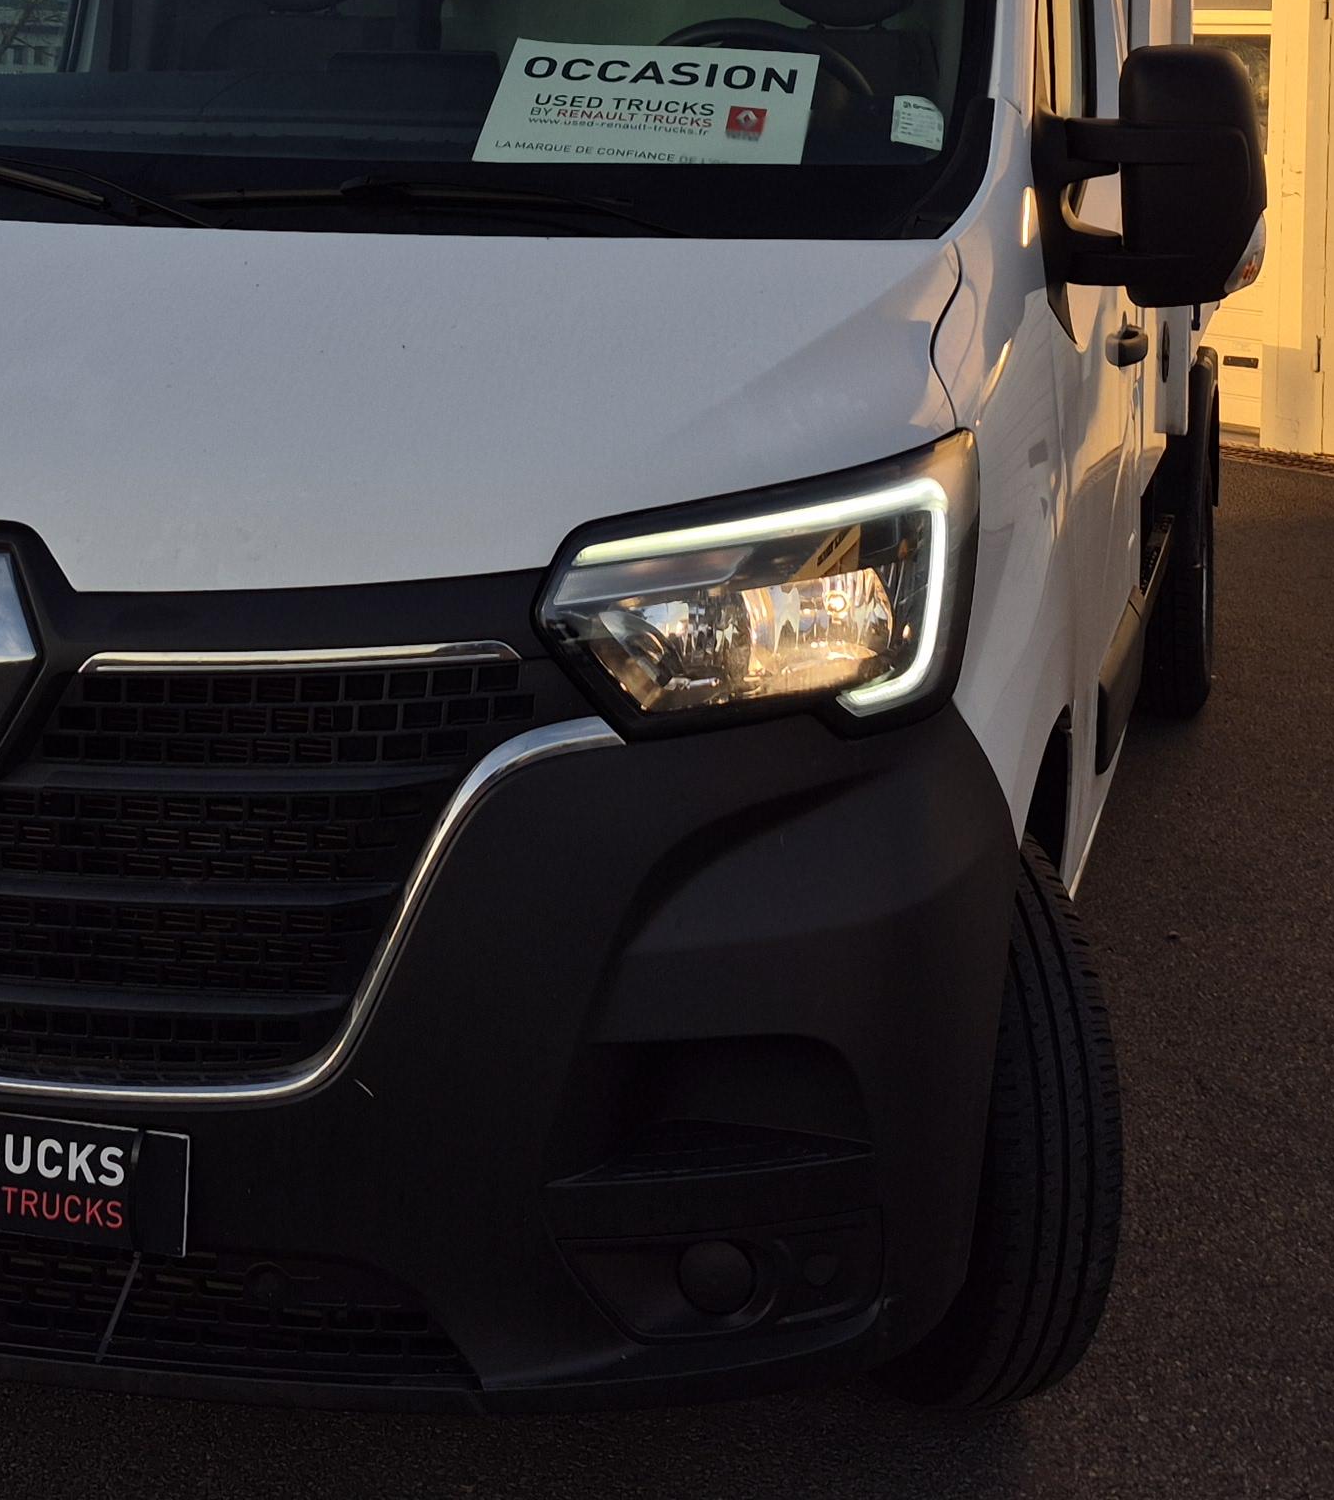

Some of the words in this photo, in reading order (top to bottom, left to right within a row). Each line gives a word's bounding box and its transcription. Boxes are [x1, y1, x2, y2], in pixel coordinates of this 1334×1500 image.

[523, 56, 798, 94] OCCASION
[534, 93, 603, 109] USED
[611, 97, 715, 116] TRUCKS
[528, 117, 709, 136] www.used-renault-trucks.fr
[529, 106, 552, 117] BY
[556, 108, 638, 122] RENAULT
[642, 113, 713, 128] TRUCKS
[495, 140, 512, 149] LA
[514, 141, 571, 153] MARQUE
[575, 146, 594, 154] DE
[597, 147, 675, 162] CONFIANCE
[1, 1186, 123, 1229] TRUCKS
